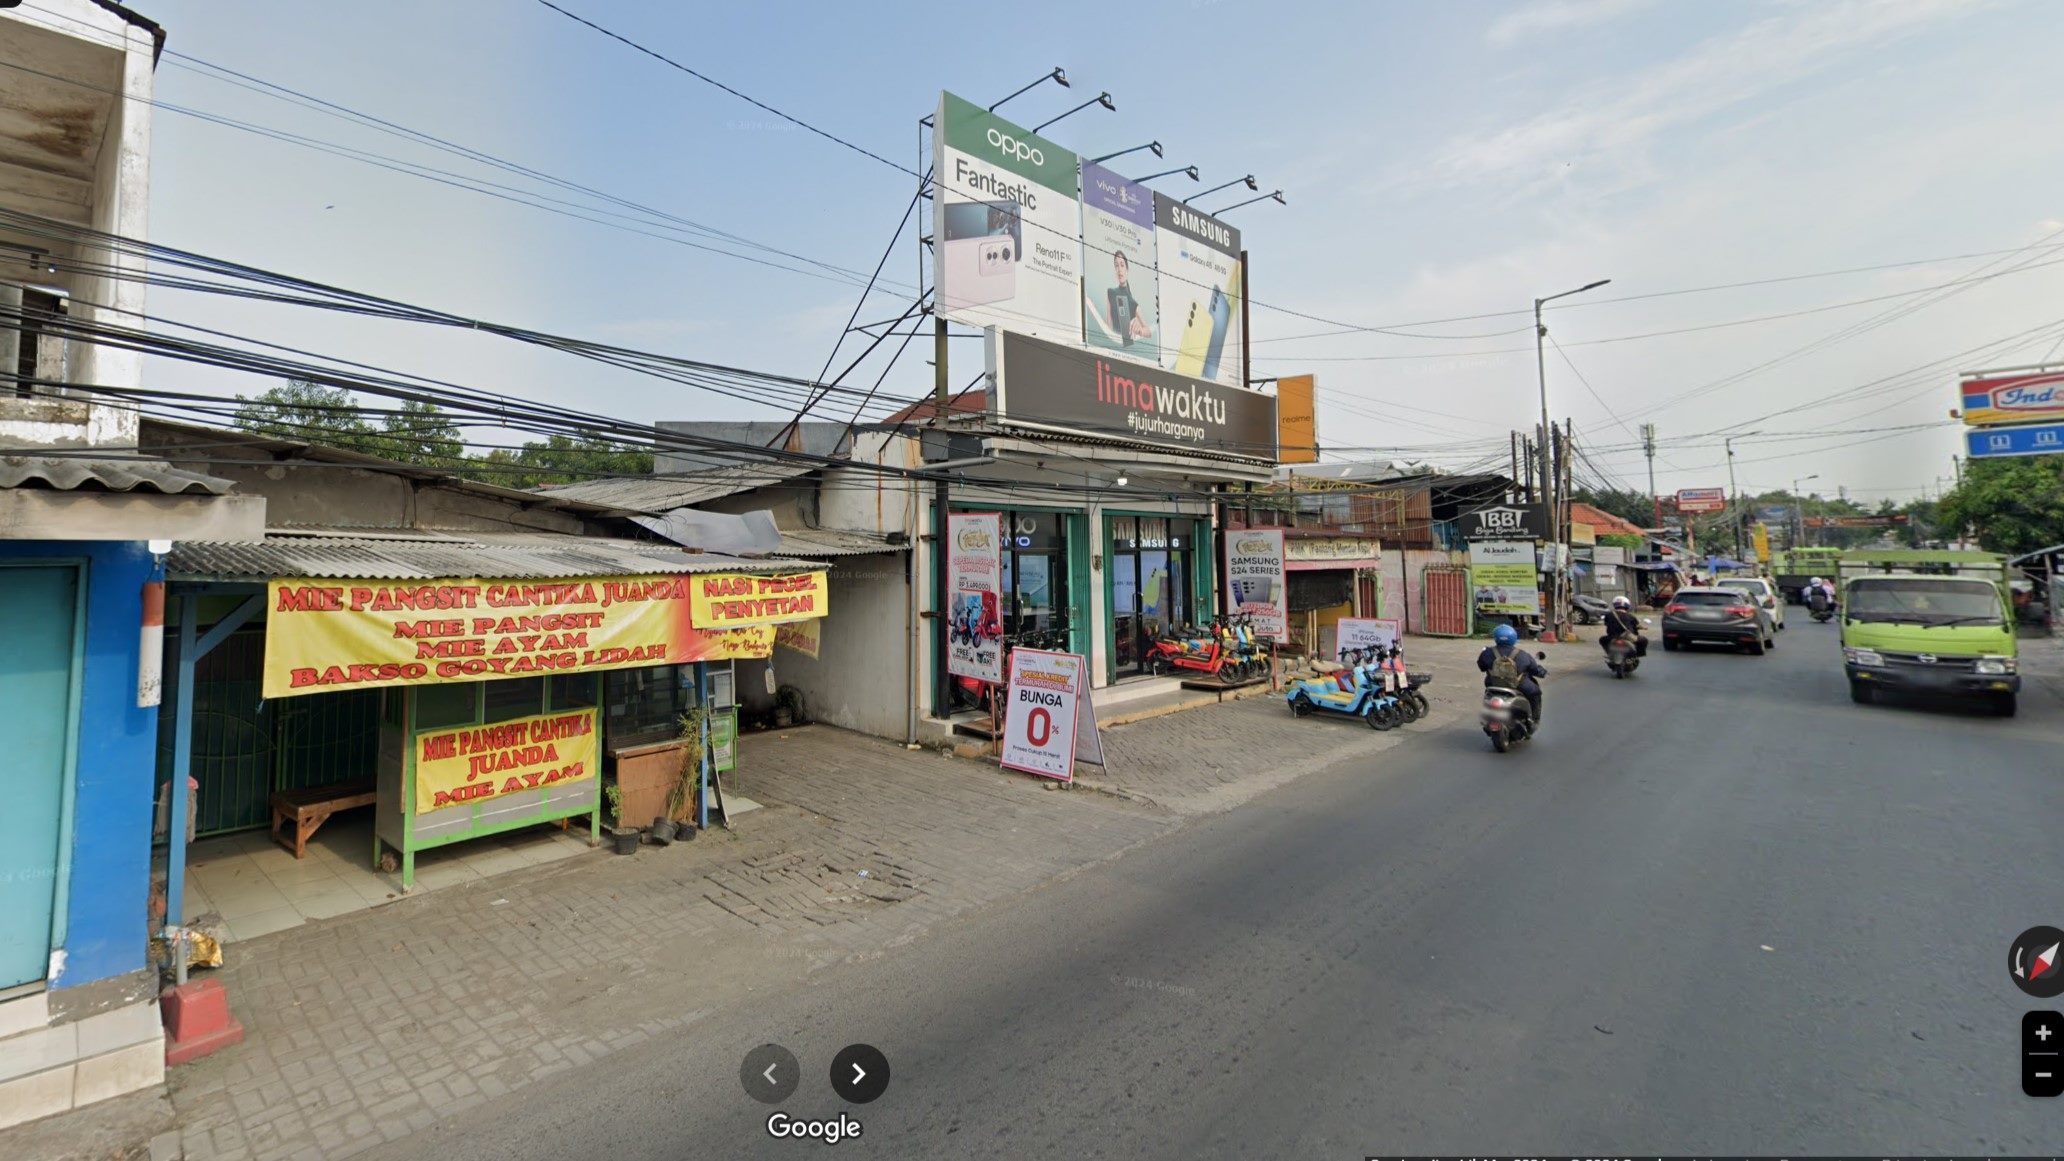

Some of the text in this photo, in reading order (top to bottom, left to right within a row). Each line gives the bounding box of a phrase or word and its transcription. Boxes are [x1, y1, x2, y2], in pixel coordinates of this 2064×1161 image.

[988, 129, 1044, 166] oppo
[956, 158, 1036, 211] Fantastic
[1096, 179, 1117, 195] vivo
[1172, 206, 1230, 247] SAMSUNG
[1097, 360, 1226, 425] limawaktu
[1128, 411, 1205, 442] #jujurharganya
[1282, 416, 1311, 424] realme
[1231, 557, 1280, 566] SAMSUNG
[1231, 566, 1280, 576] S24 SERIES
[277, 579, 686, 611] MIE PANGSIT CANTIKA JUANDA
[704, 578, 752, 597] NASI
[711, 595, 814, 620] PENYETAN
[393, 613, 605, 638] MIE PANGSIT
[1359, 634, 1381, 642] 64Gb
[416, 632, 589, 659] MIE AYAM
[290, 644, 666, 688] BAKSO GOYANG LIDAH
[1020, 690, 1062, 708] BUNGA
[423, 714, 592, 762] MIE PANGSIT CANTIKA
[1027, 707, 1060, 747] 0 %
[467, 744, 559, 781] JUANDA
[434, 762, 584, 807] MIE AYAM
